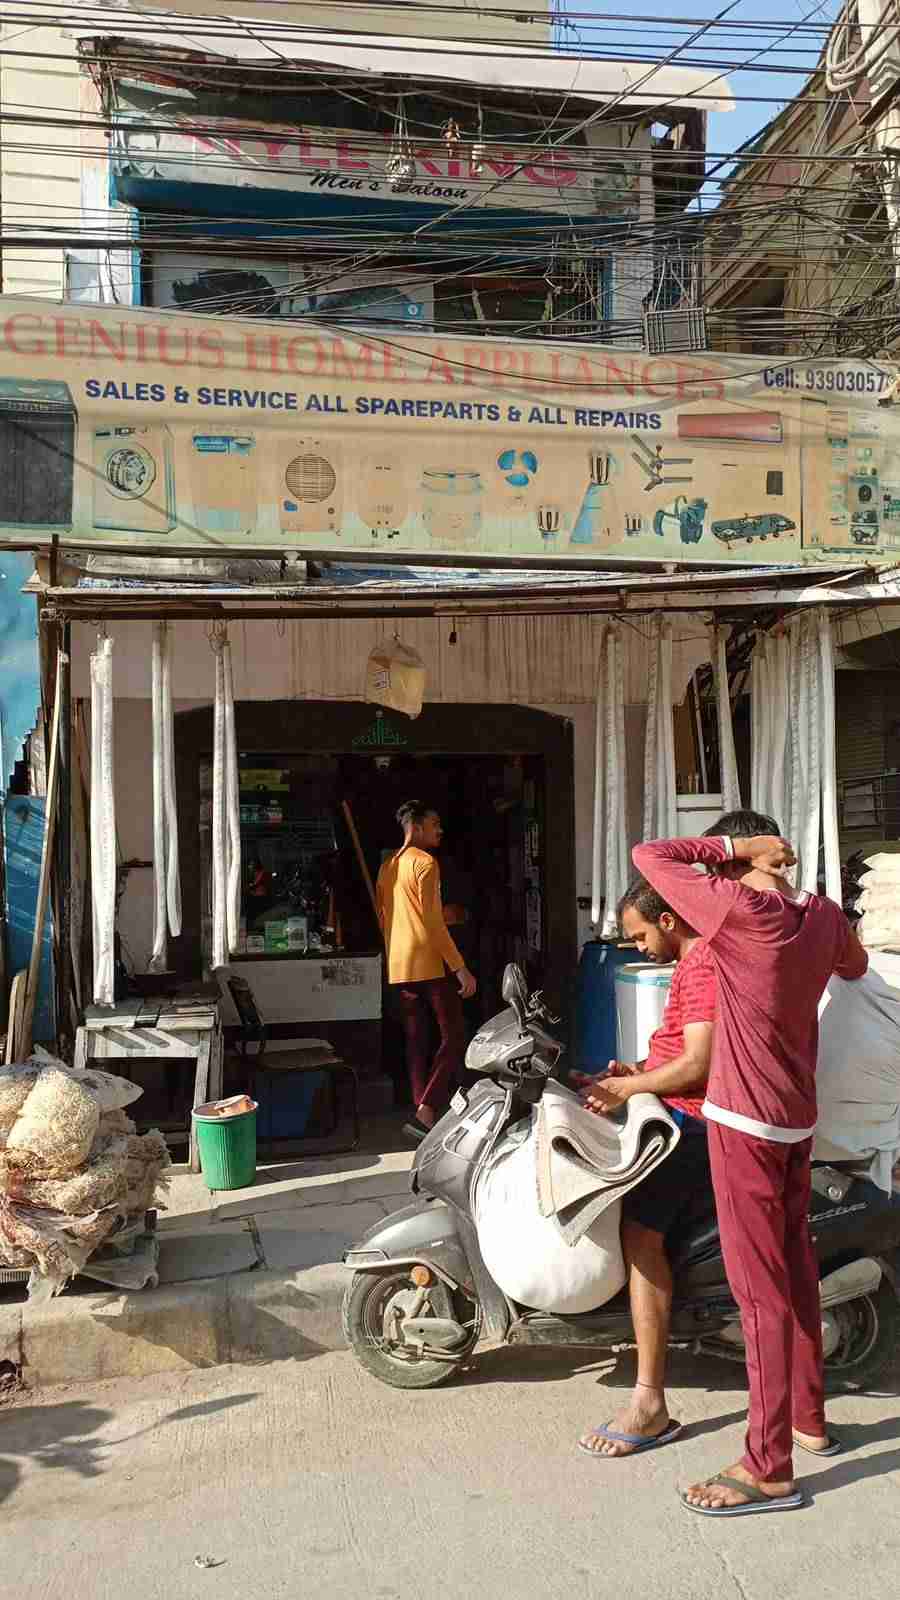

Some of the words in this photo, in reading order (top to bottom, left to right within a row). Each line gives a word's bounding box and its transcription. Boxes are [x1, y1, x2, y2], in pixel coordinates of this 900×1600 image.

[309, 173, 382, 192] Mens
[4, 313, 224, 368] GENIUS
[241, 333, 407, 384] HOME
[421, 344, 724, 401] APPLIANCES
[763, 368, 799, 389] Cell:
[86, 380, 164, 402] SALES
[174, 386, 189, 403] &
[198, 387, 297, 410] SERVICE
[306, 395, 348, 412] ALL
[357, 397, 499, 421] SPAREPARTS
[508, 406, 522, 421] &
[528, 407, 567, 425] ALL
[575, 409, 661, 430] REPAIRS
